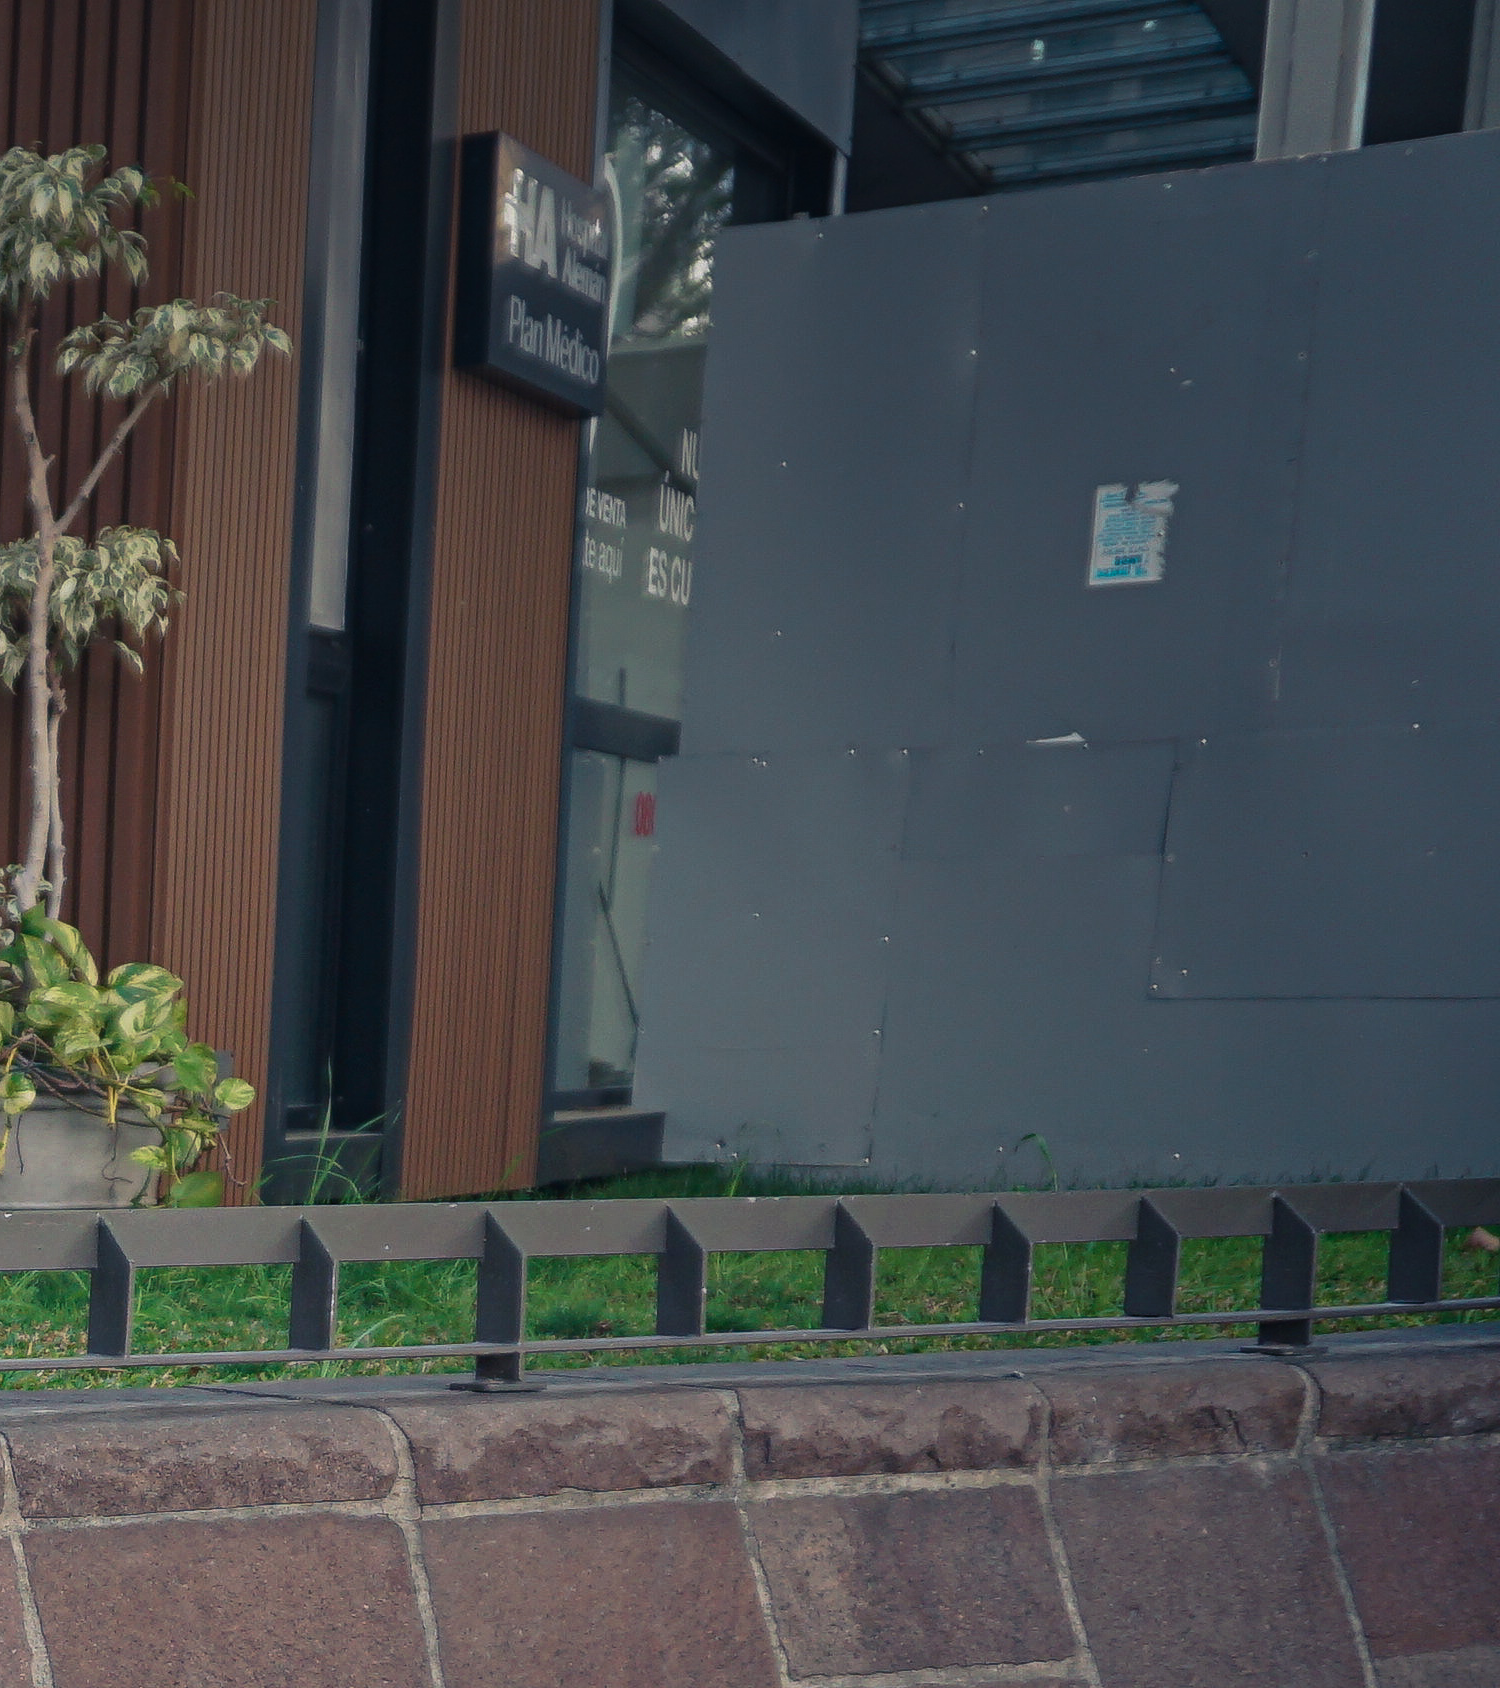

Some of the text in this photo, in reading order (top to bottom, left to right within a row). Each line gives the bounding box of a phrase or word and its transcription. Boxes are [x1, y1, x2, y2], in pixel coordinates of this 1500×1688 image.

[509, 295, 599, 384] Plan Médico
[599, 536, 624, 584] aquí
[648, 547, 667, 598] ES
